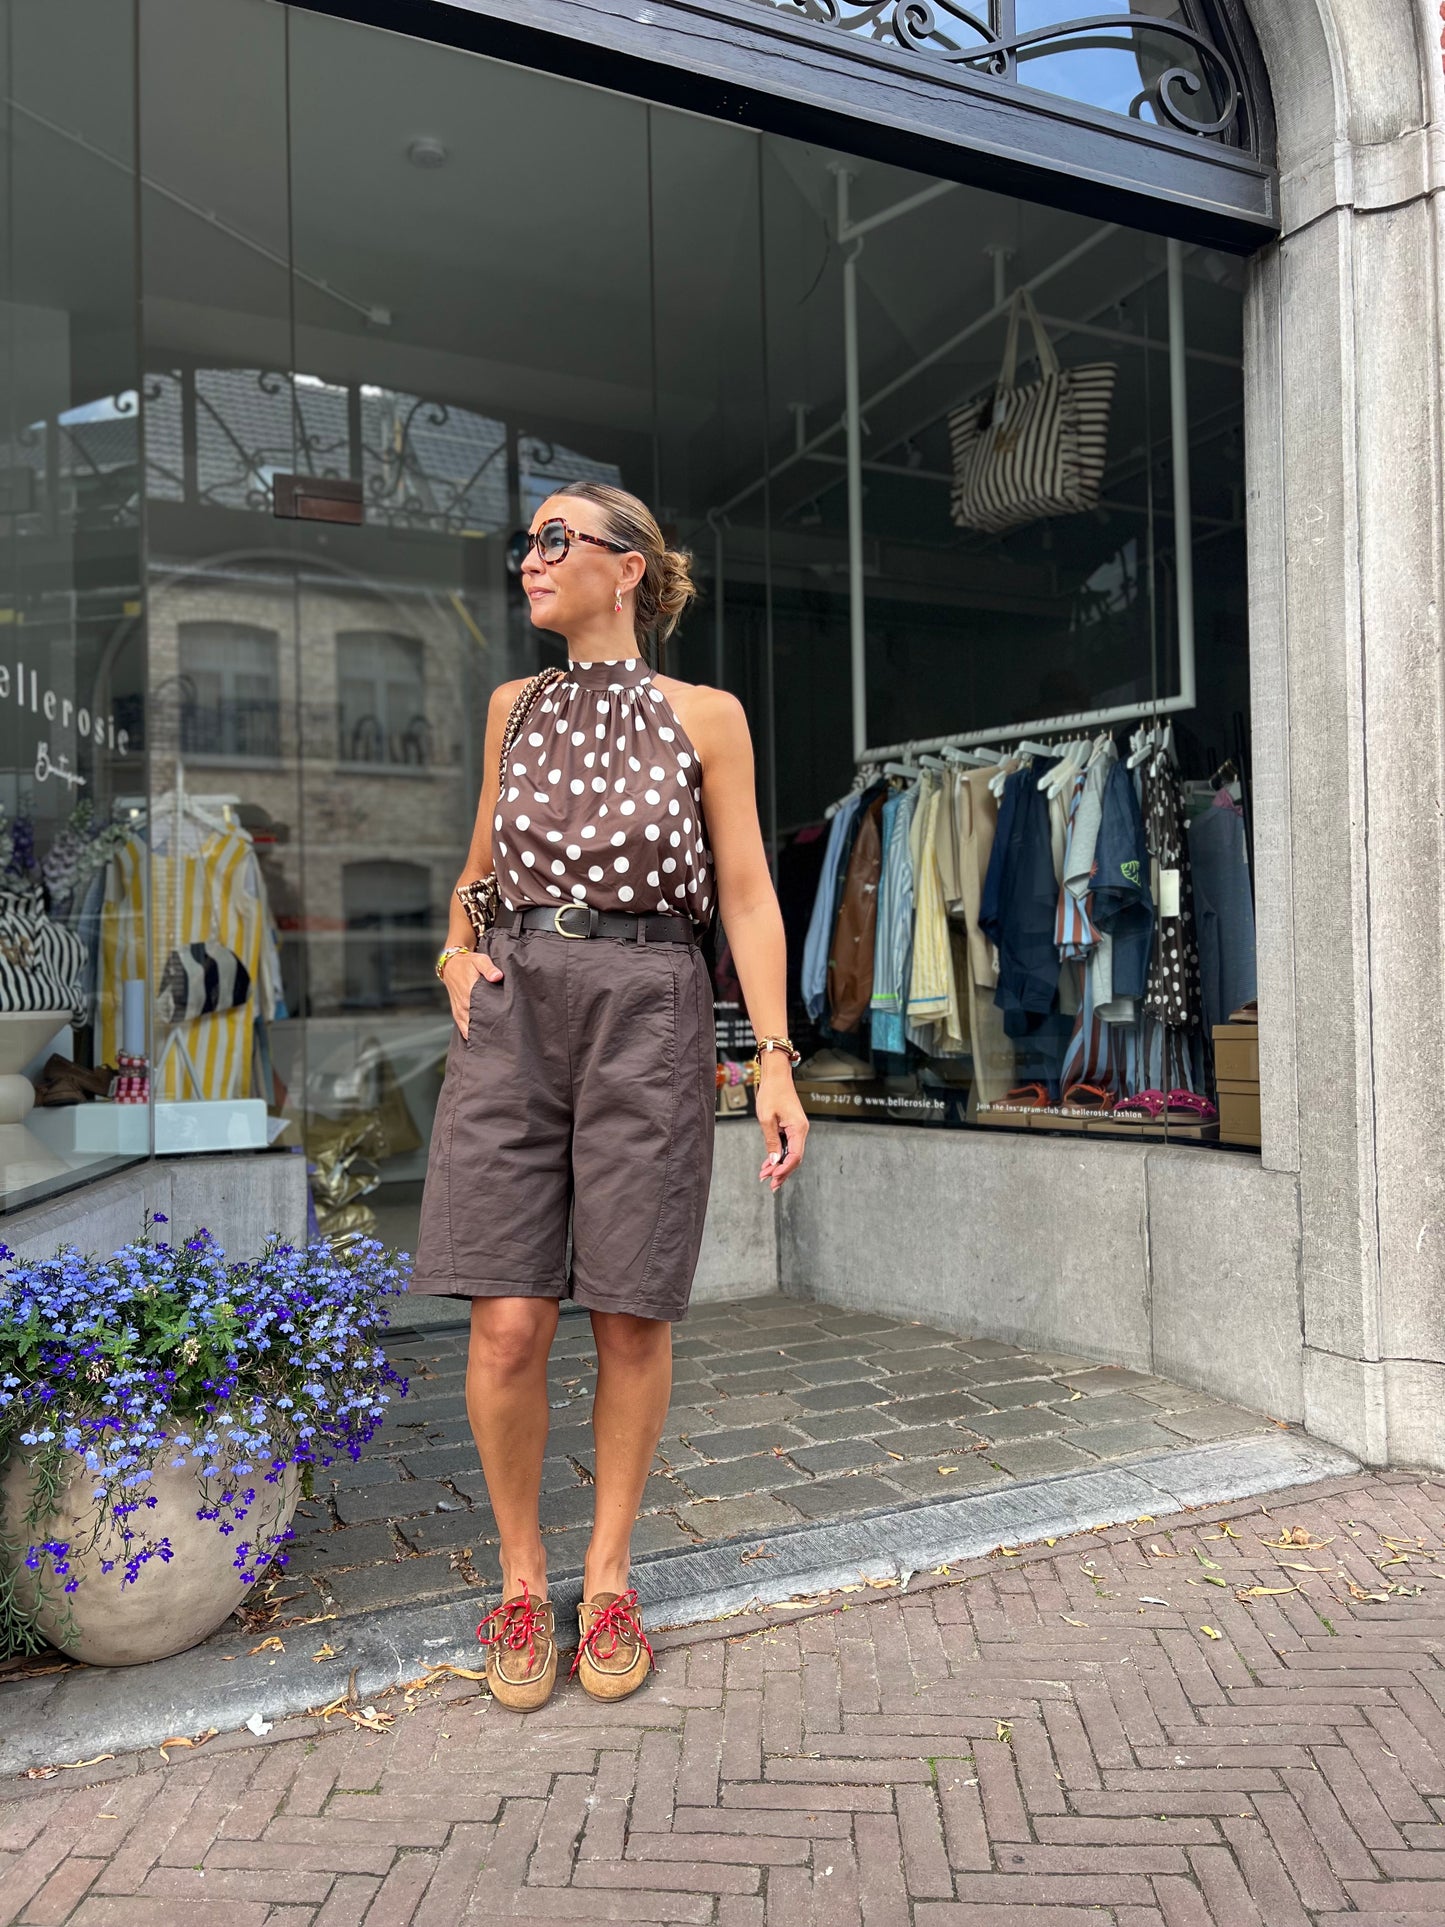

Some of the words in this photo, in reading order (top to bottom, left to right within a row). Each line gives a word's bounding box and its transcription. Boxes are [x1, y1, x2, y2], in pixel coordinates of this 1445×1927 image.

[0, 662, 129, 756] ellerosie
[810, 1092, 831, 1103] Shop
[833, 1095, 851, 1105] 24/7
[853, 1095, 863, 1106] @
[865, 1096, 945, 1109] www.bellerosie.be
[976, 1102, 991, 1112] Join
[1071, 1108, 1142, 1119] bellerosie_fashion
